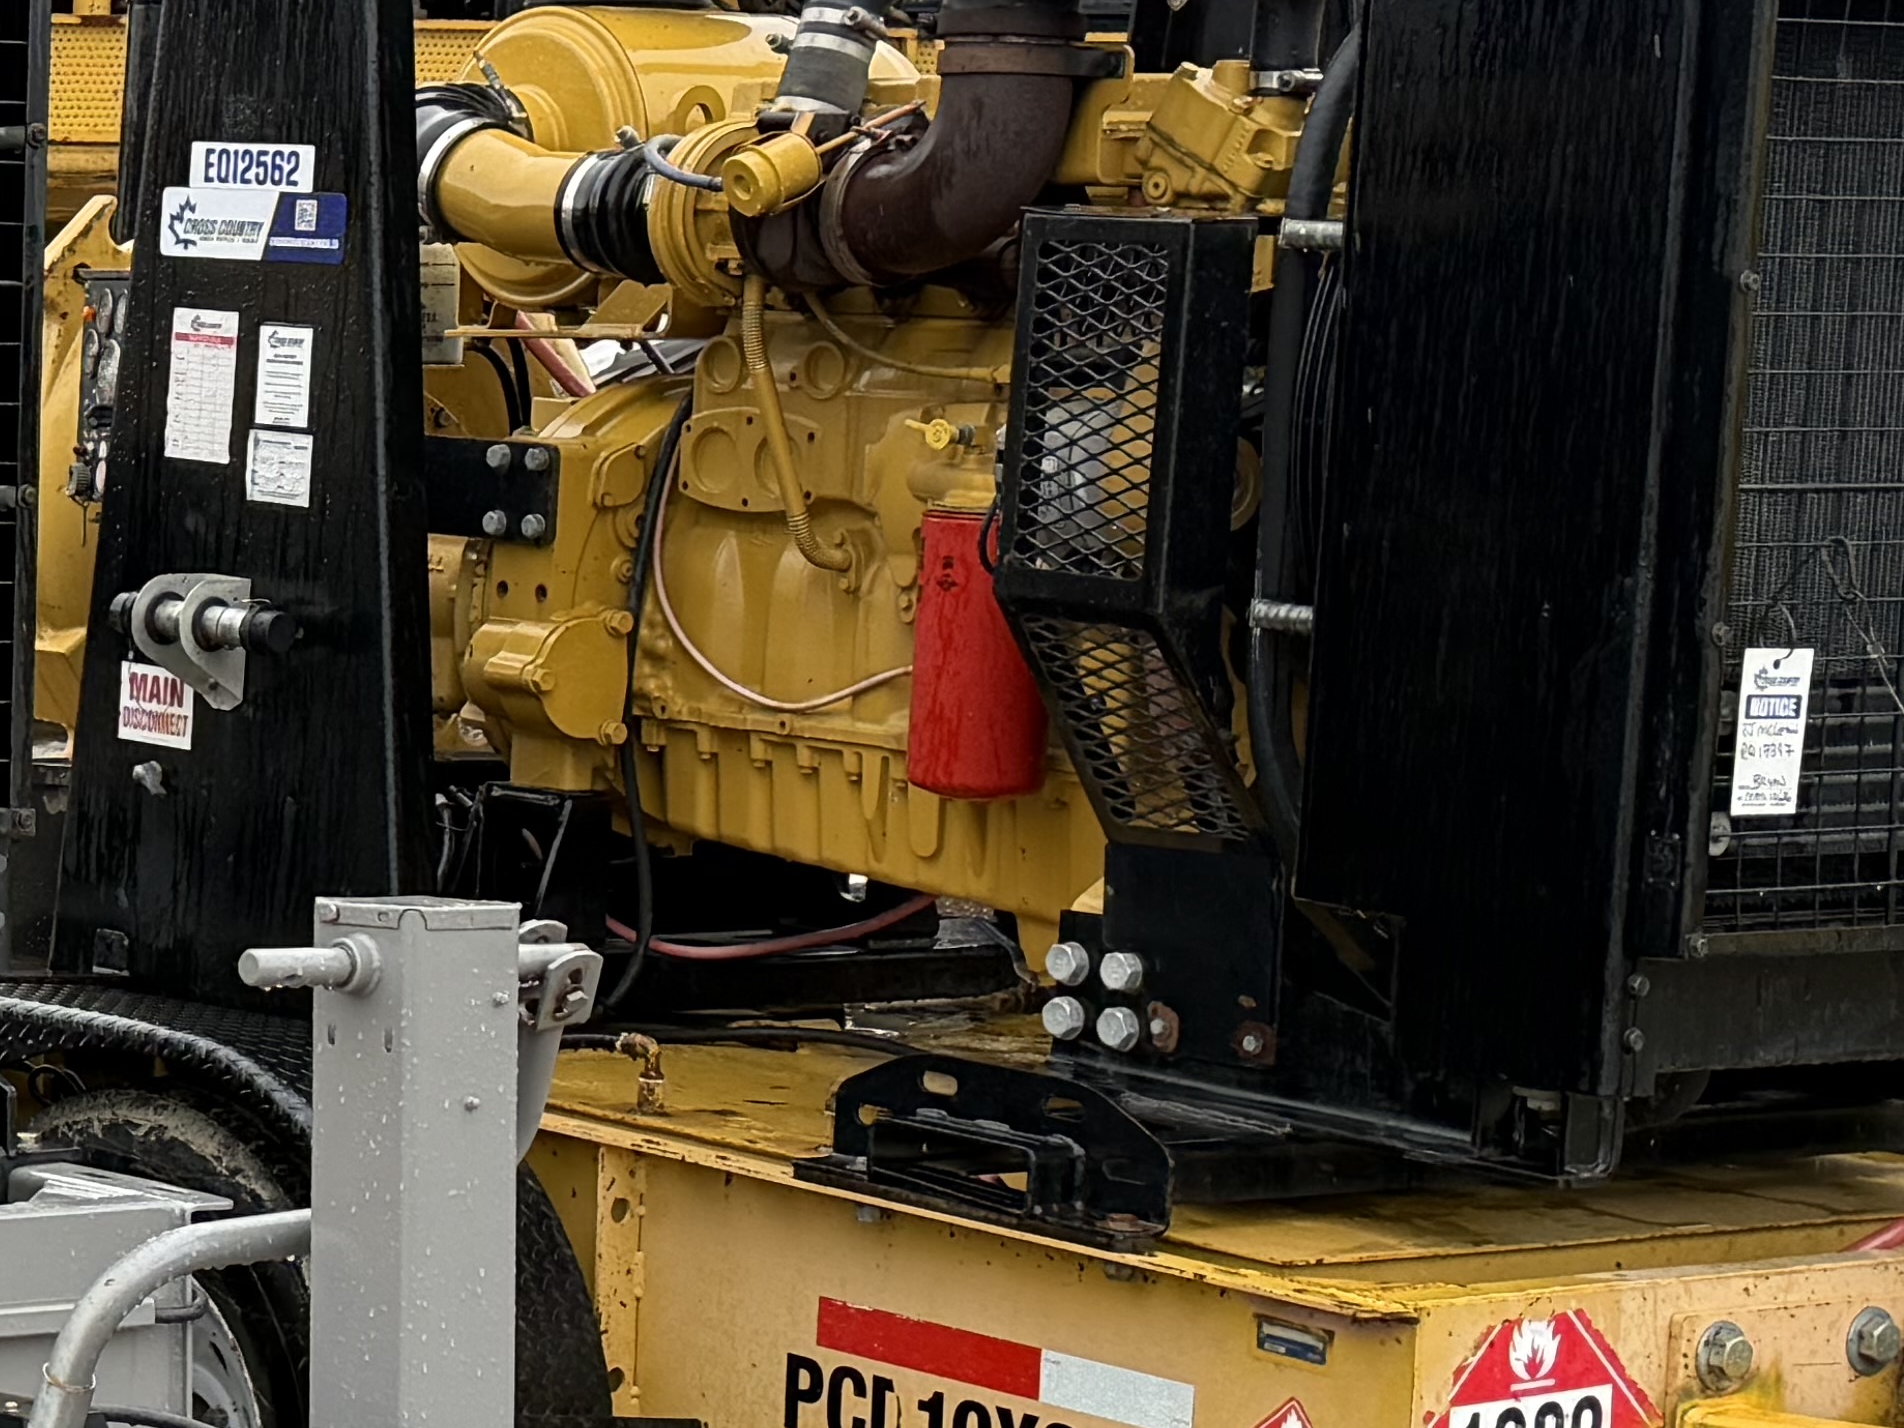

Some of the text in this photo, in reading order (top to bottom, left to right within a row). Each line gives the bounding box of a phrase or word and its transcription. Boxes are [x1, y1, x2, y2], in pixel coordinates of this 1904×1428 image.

[203, 148, 301, 187] EQ12562
[129, 672, 185, 708] MAIN
[122, 706, 189, 737] DISCONNECT
[1749, 697, 1798, 718] NOTICE
